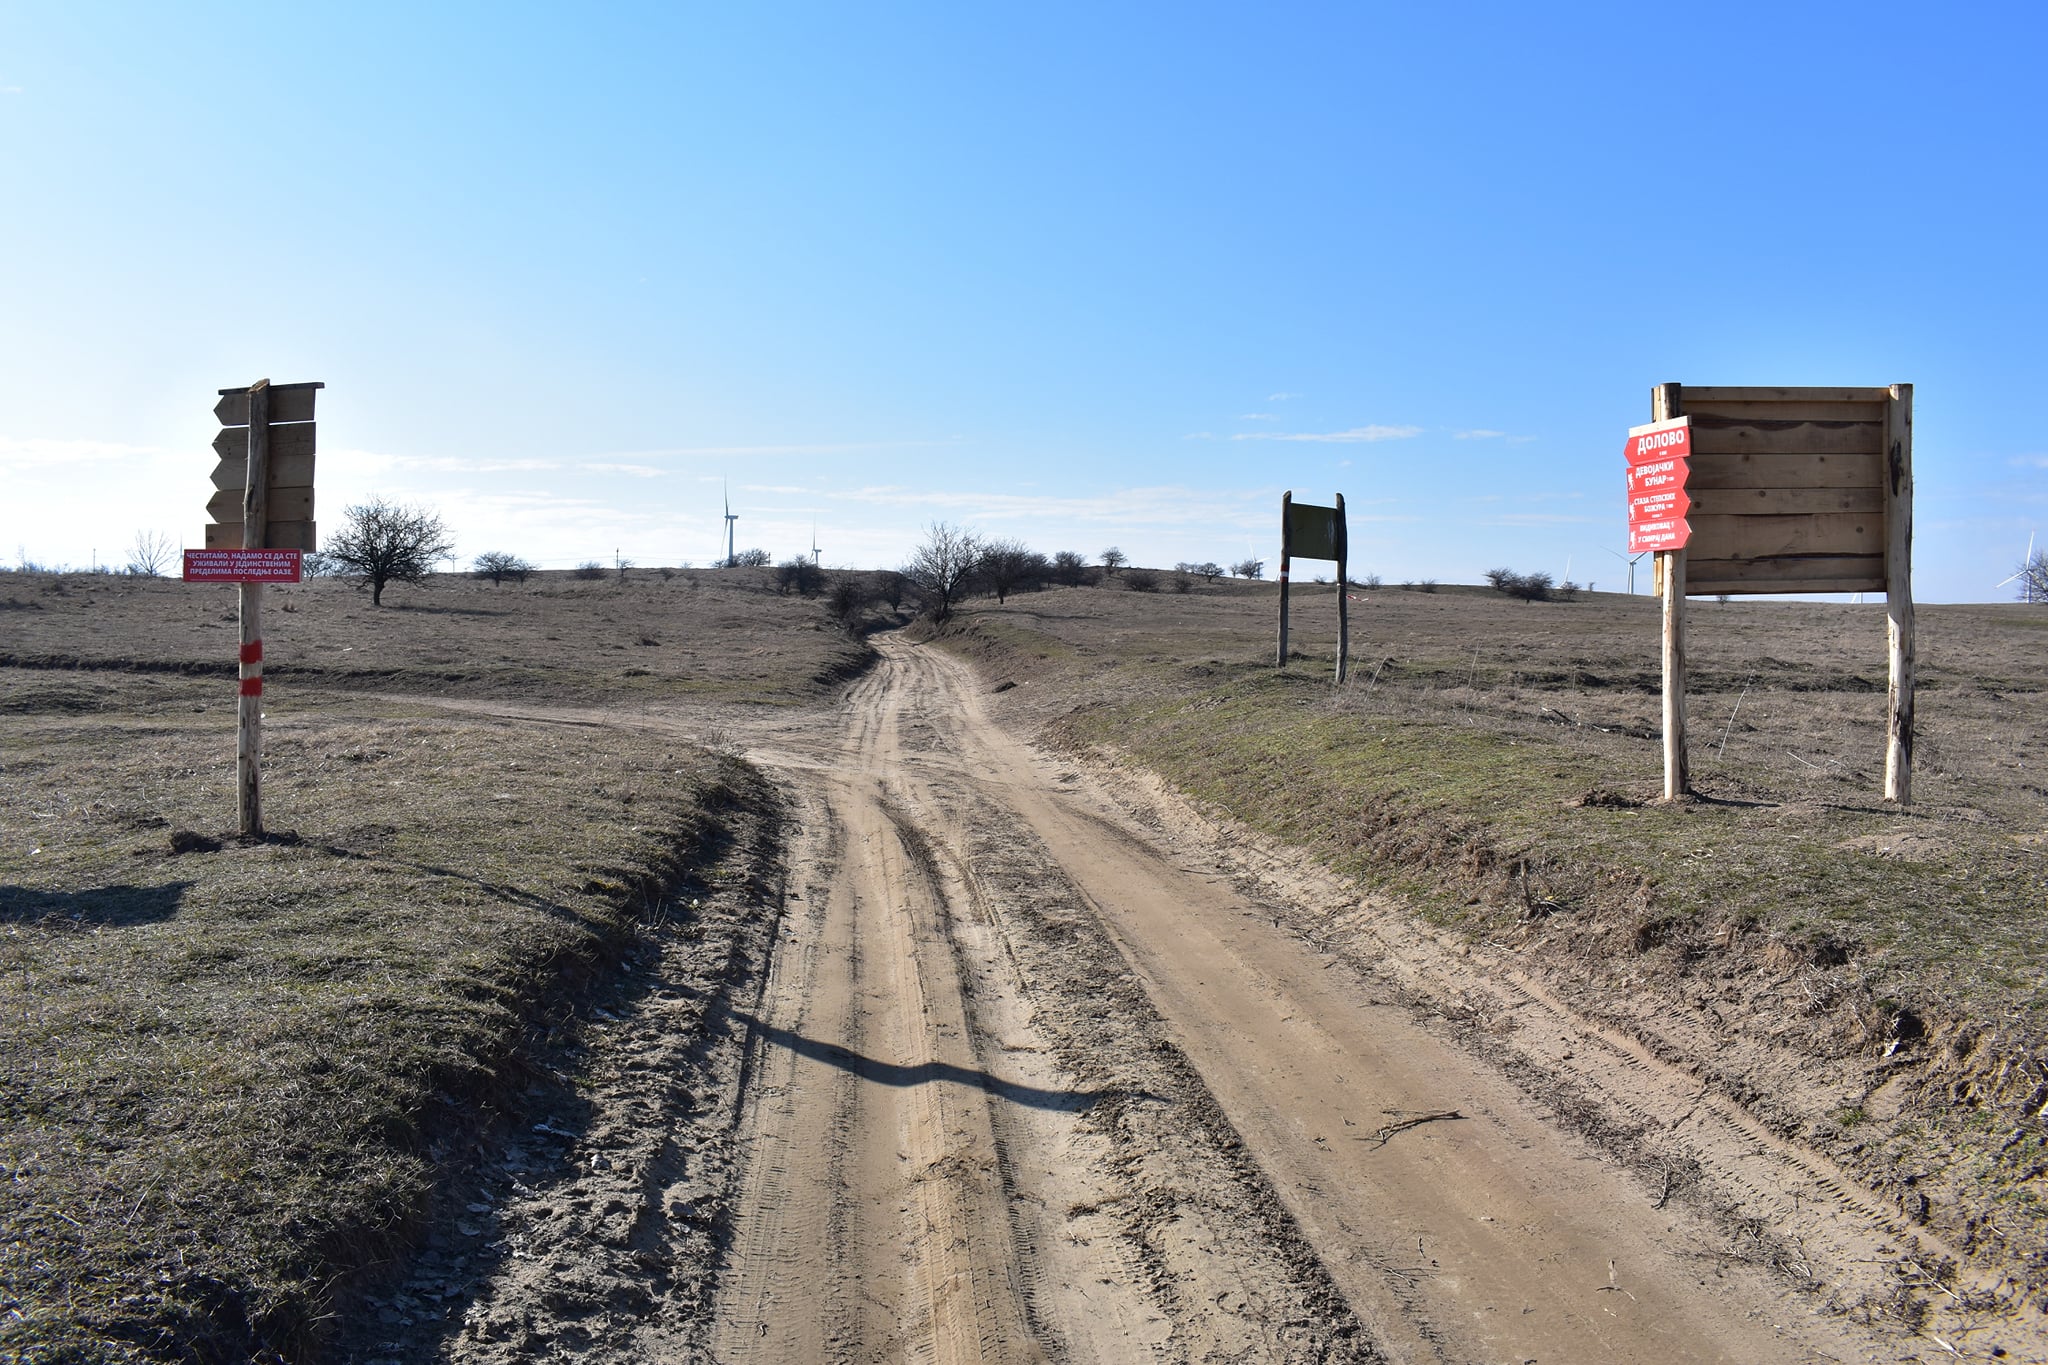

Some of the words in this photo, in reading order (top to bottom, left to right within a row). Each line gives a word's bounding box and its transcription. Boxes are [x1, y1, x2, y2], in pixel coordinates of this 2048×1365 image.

[1637, 430, 1684, 455] ДОЛОВО
[1636, 461, 1674, 478] ДЕВОЈАЧКИ
[1645, 475, 1666, 486] БУНАР
